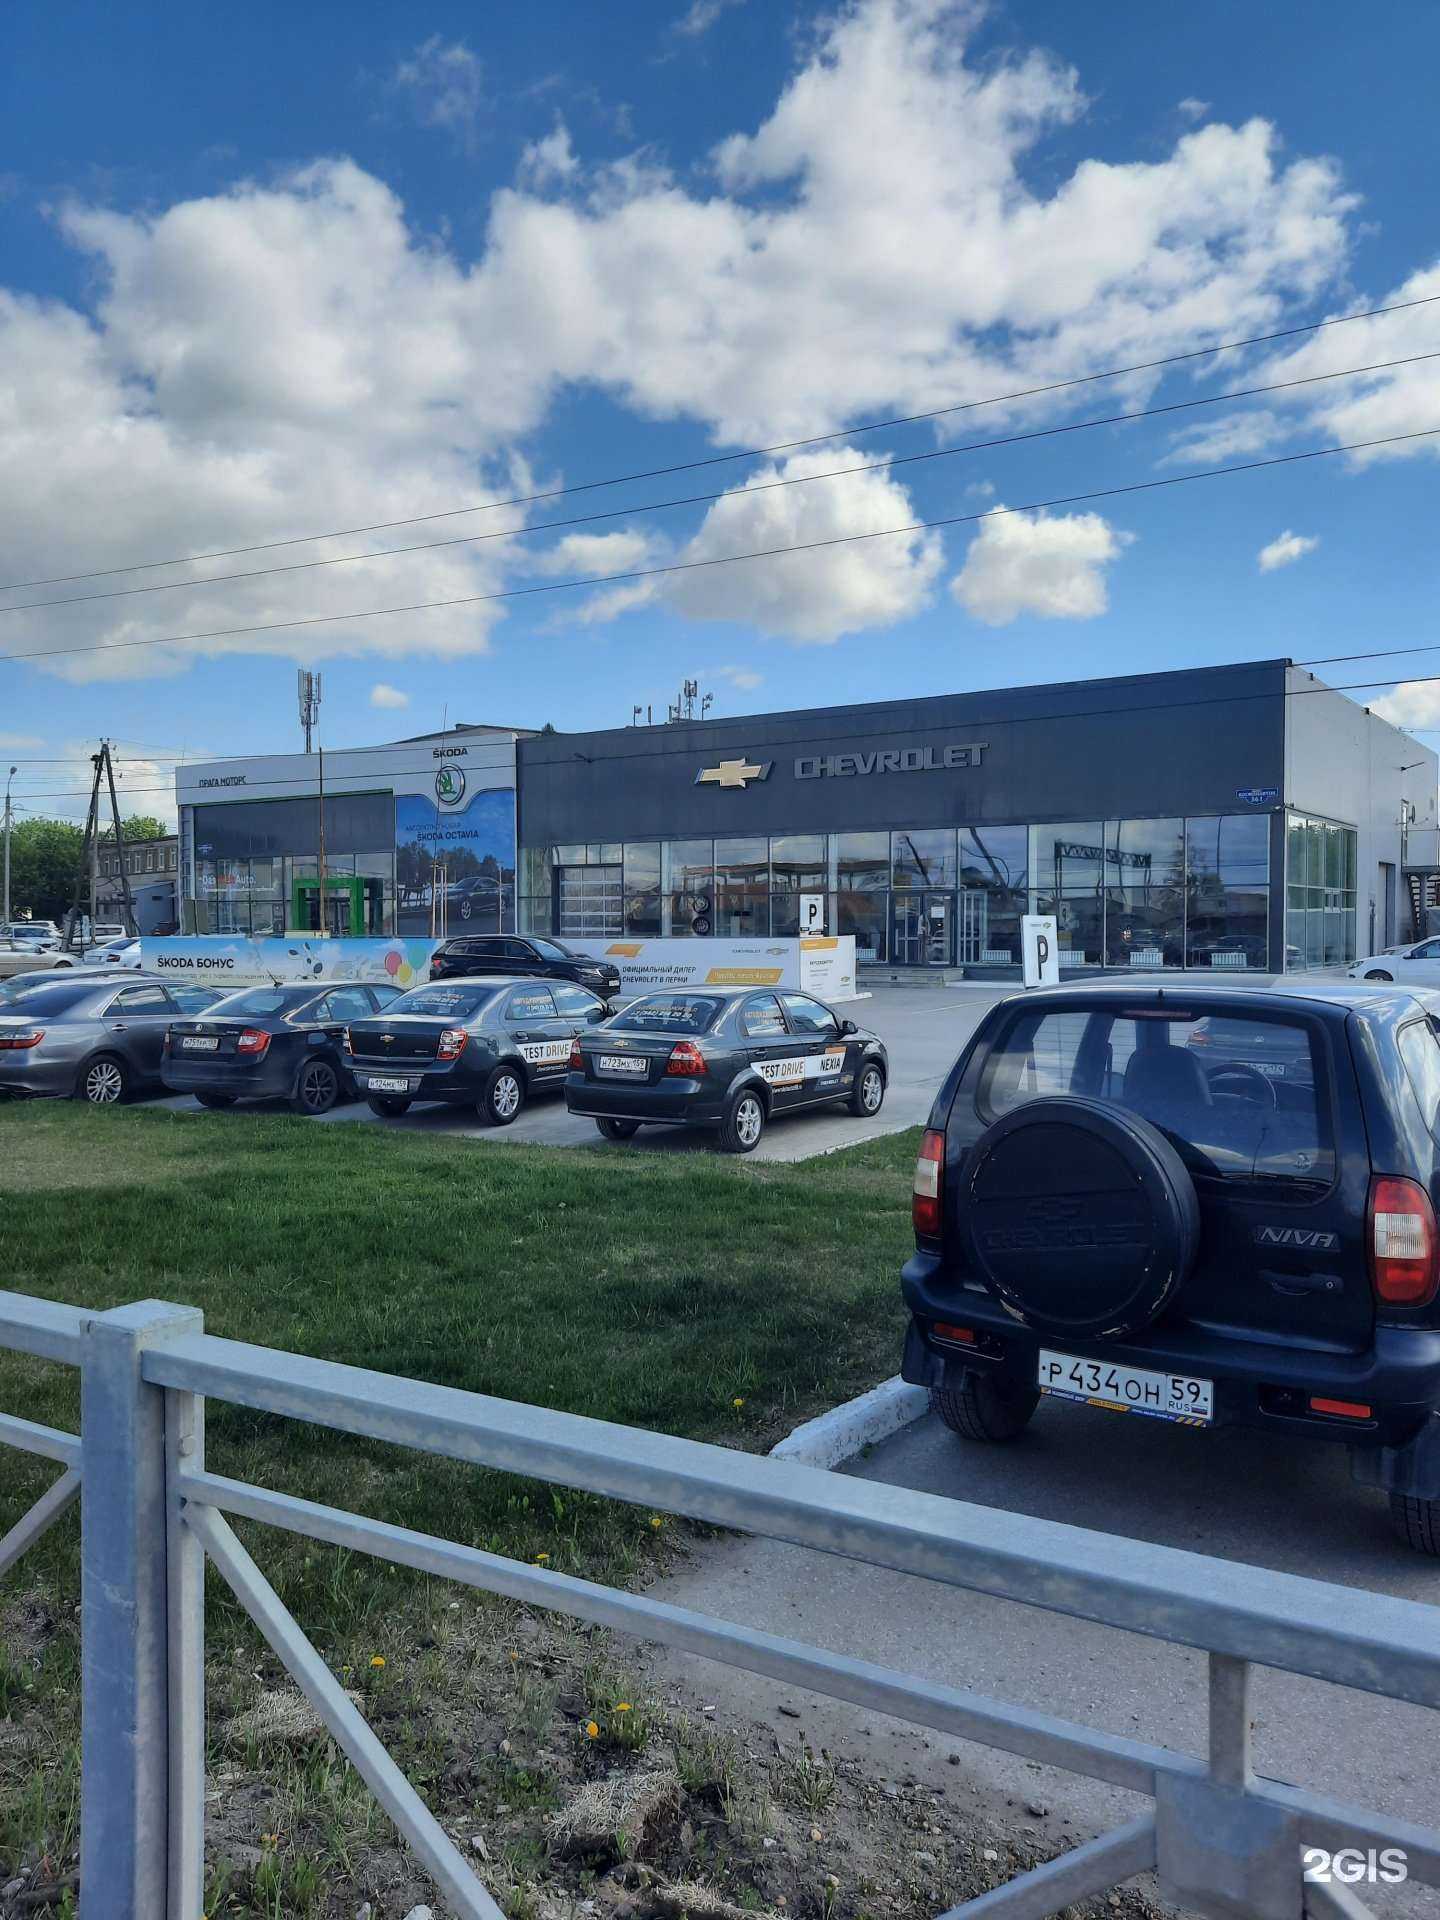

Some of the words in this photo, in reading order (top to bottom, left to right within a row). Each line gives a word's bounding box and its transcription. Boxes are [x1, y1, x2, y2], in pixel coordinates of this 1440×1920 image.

[433, 748, 468, 759] ŠKODA
[794, 743, 989, 780] CHEVROLET
[199, 779, 219, 787] ПРАГА
[220, 776, 247, 786] МОТОРС
[417, 831, 443, 841] ŠKODA
[445, 830, 479, 840] OCTAVIA
[809, 904, 818, 924] P
[157, 954, 194, 968] ŠKODA
[196, 957, 234, 969] БОНУС
[1036, 935, 1049, 980] P
[622, 966, 673, 974] ОФИЦИАЛЬНЫЙ
[673, 966, 697, 974] ДИЛЕР
[523, 1046, 543, 1060] TEST
[546, 1043, 570, 1057] DRIVE
[760, 1065, 780, 1079] TEST
[780, 1061, 804, 1077] DRIVE
[820, 1058, 841, 1071] NEXIA
[1260, 1227, 1335, 1248] NIVA
[1171, 1378, 1201, 1403] 59
[1168, 1400, 1190, 1412] RUS
